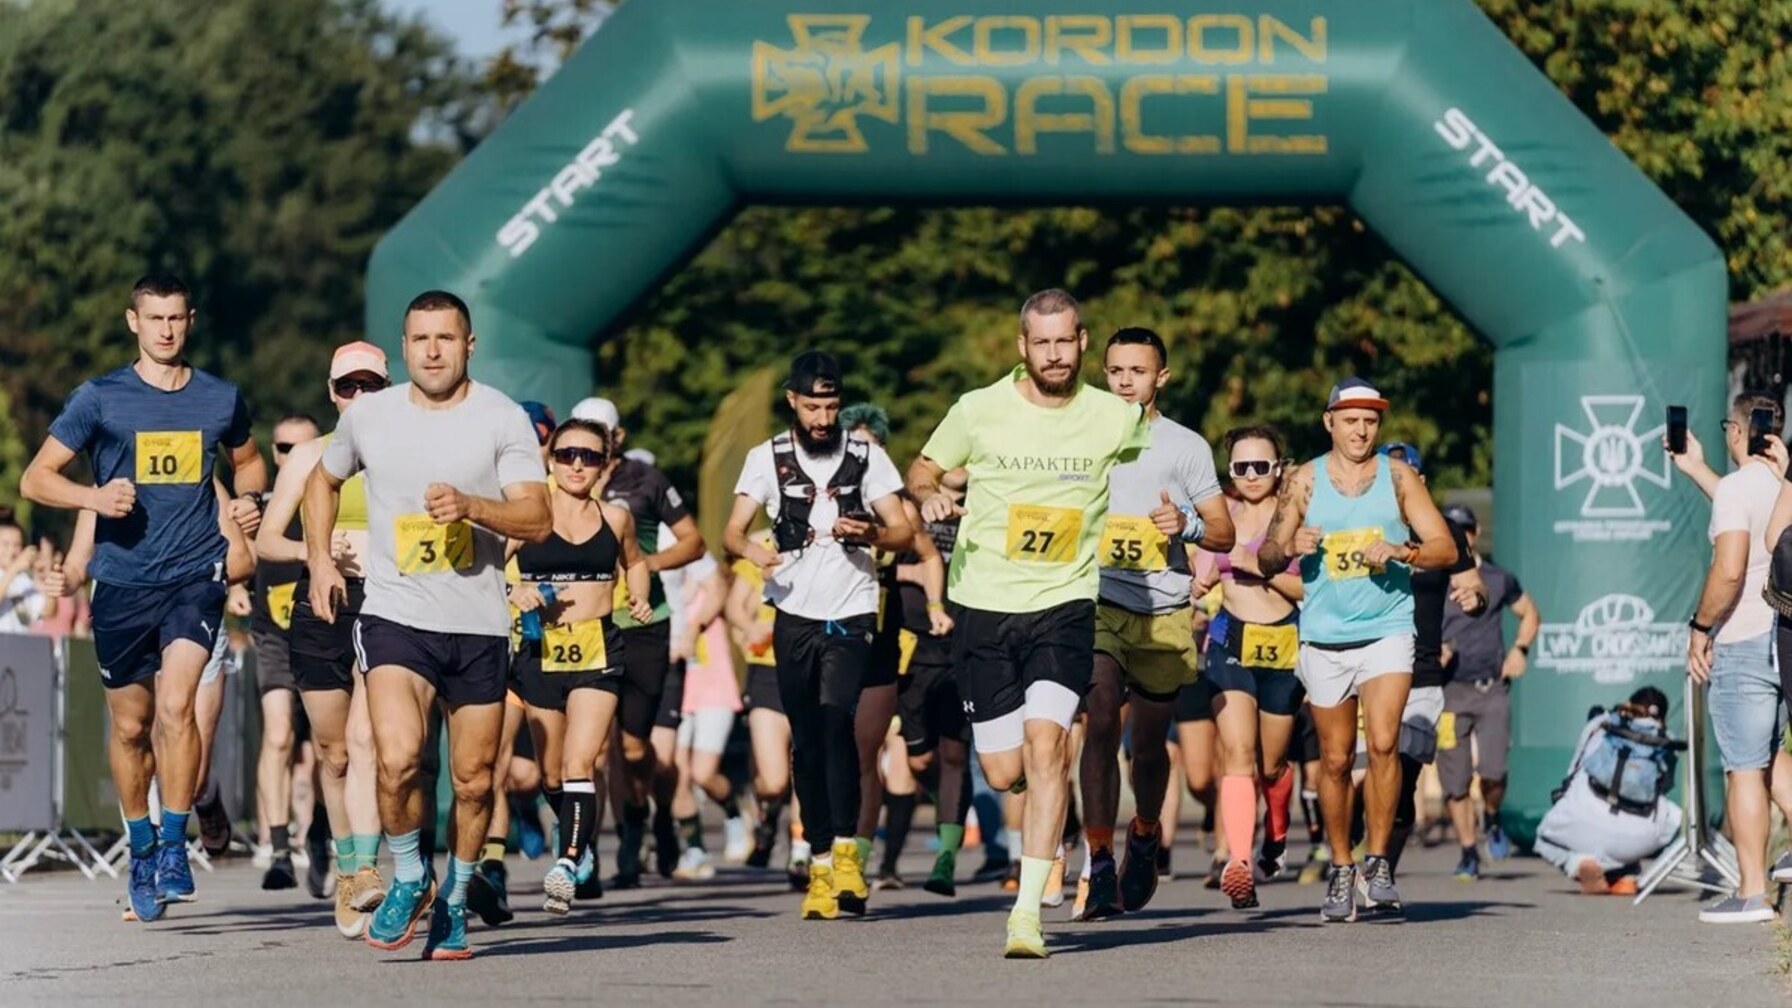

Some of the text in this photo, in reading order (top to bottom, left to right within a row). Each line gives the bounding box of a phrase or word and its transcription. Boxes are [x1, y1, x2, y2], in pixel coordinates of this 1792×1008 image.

[907, 15, 1327, 66] KORDON
[907, 75, 1328, 155] RACE
[496, 108, 638, 258] START
[1434, 107, 1586, 248] START
[149, 455, 177, 475] 10
[996, 455, 1094, 472] ХАРАКТЕР
[419, 540, 437, 564] 3
[1021, 530, 1055, 553] 27
[1111, 539, 1143, 561] 35
[1336, 551, 1365, 571] 39
[553, 644, 583, 663] 28
[1255, 645, 1279, 661] 13
